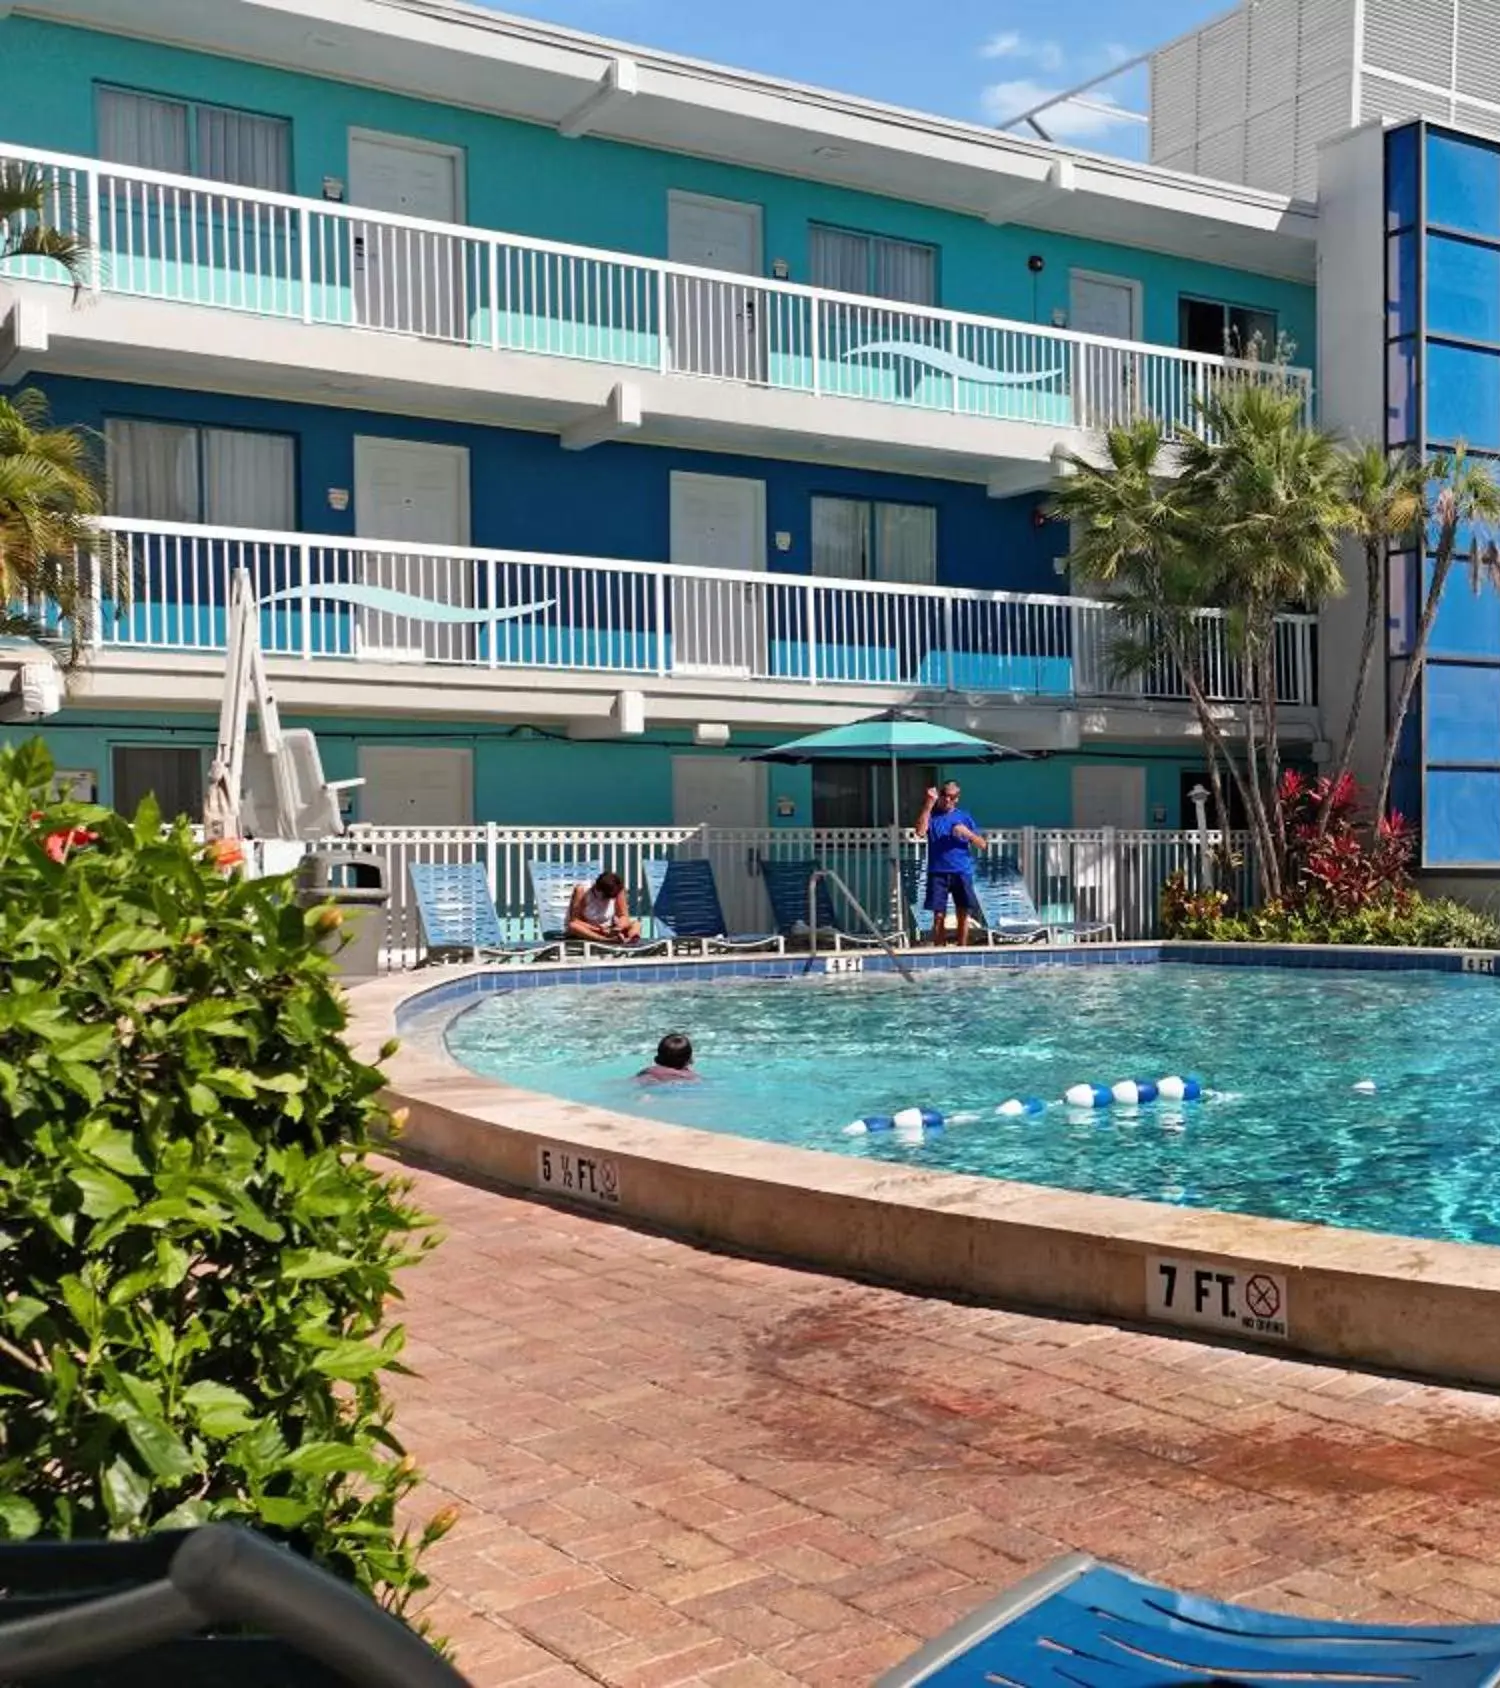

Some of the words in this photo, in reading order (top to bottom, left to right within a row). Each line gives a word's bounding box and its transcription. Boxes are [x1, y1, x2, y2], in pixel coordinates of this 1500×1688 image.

[1479, 958, 1493, 972] FT
[541, 1150, 552, 1182] 5
[1159, 1264, 1177, 1307] 7
